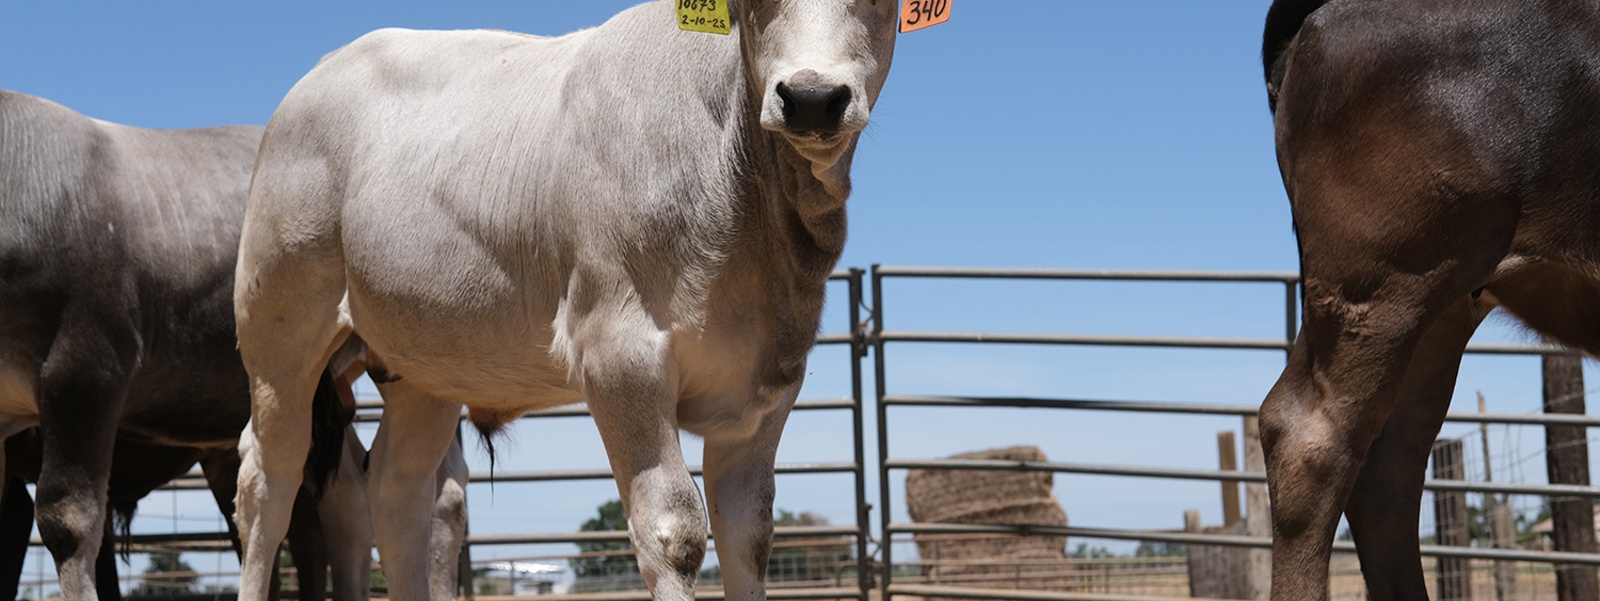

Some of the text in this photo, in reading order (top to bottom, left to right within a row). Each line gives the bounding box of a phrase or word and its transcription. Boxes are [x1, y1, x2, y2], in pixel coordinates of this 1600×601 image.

[678, 0, 717, 12] 10673
[906, 0, 947, 25] 340
[681, 14, 726, 28] 2-10-25
